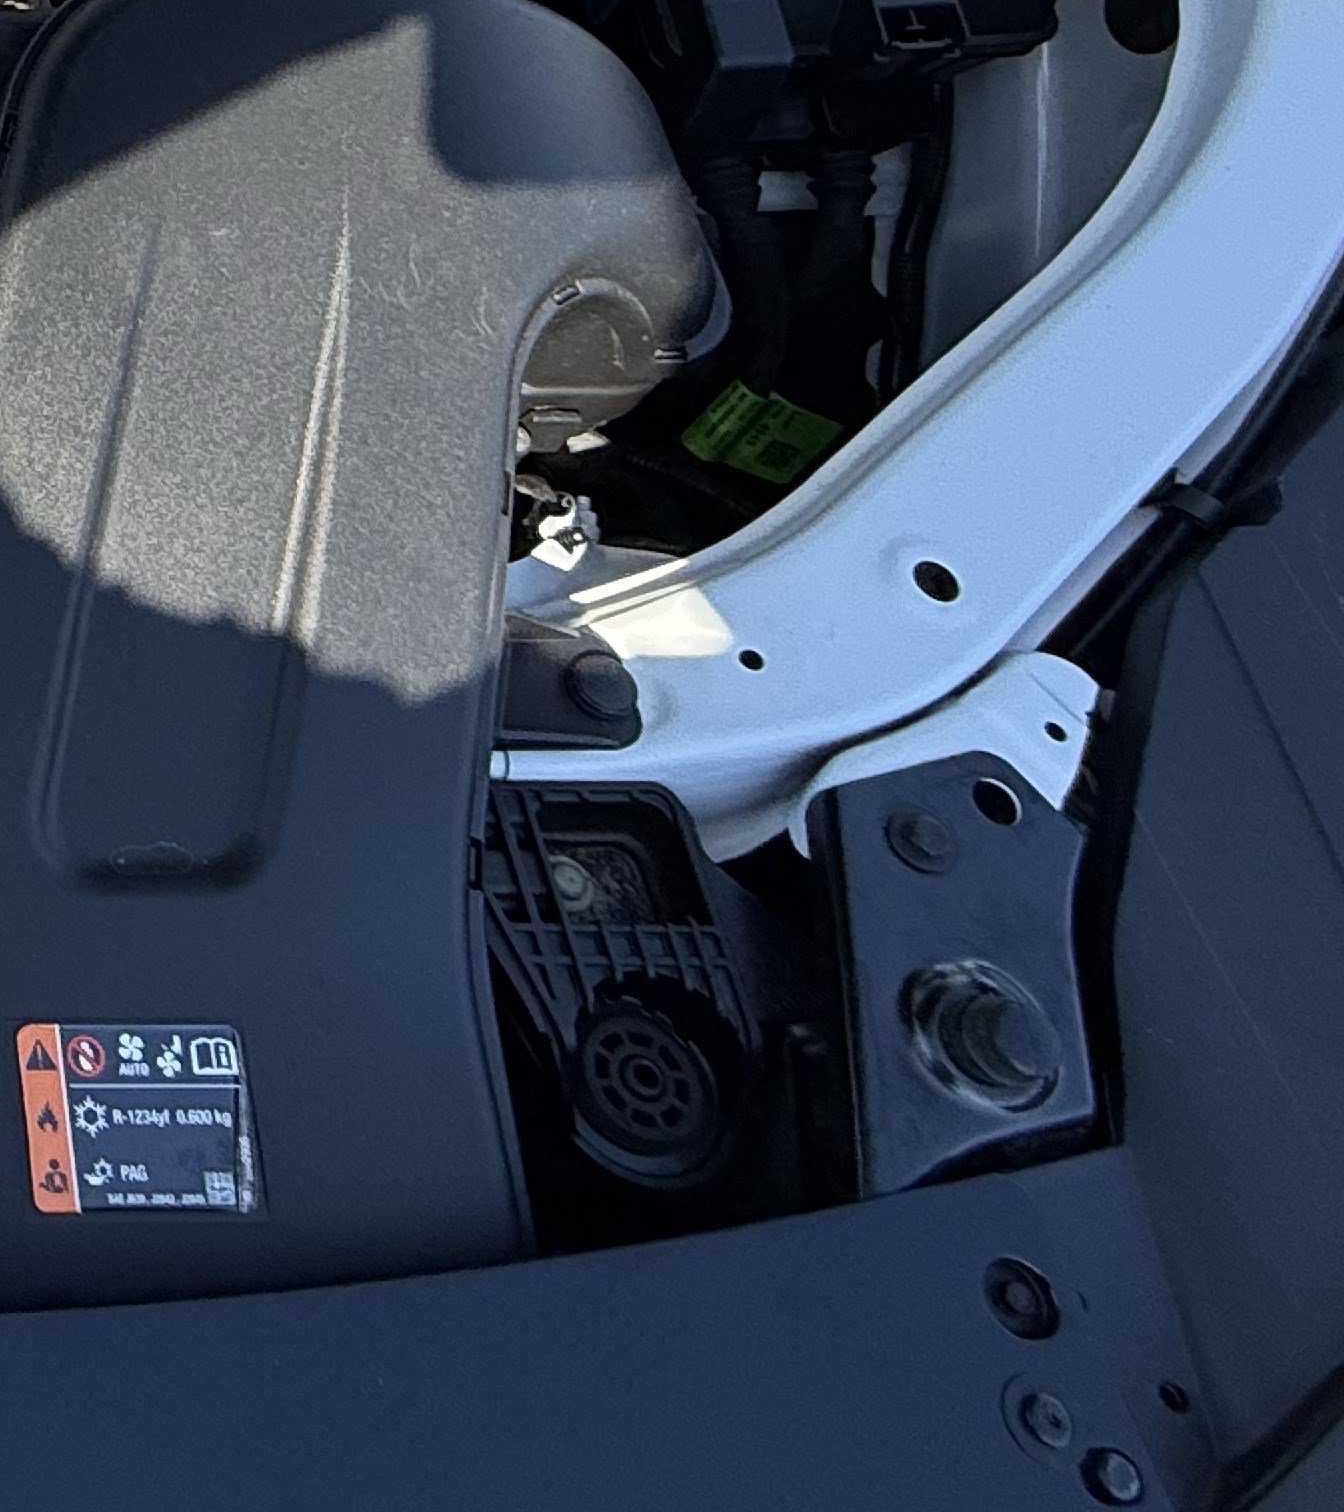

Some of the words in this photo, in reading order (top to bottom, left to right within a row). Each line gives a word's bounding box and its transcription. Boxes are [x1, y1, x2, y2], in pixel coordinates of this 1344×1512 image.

[118, 1062, 151, 1077] AUTO
[111, 1108, 172, 1128] R-1234yf
[176, 1108, 213, 1126] 0.600
[214, 1108, 233, 1128] kg
[120, 1163, 150, 1182] PAG
